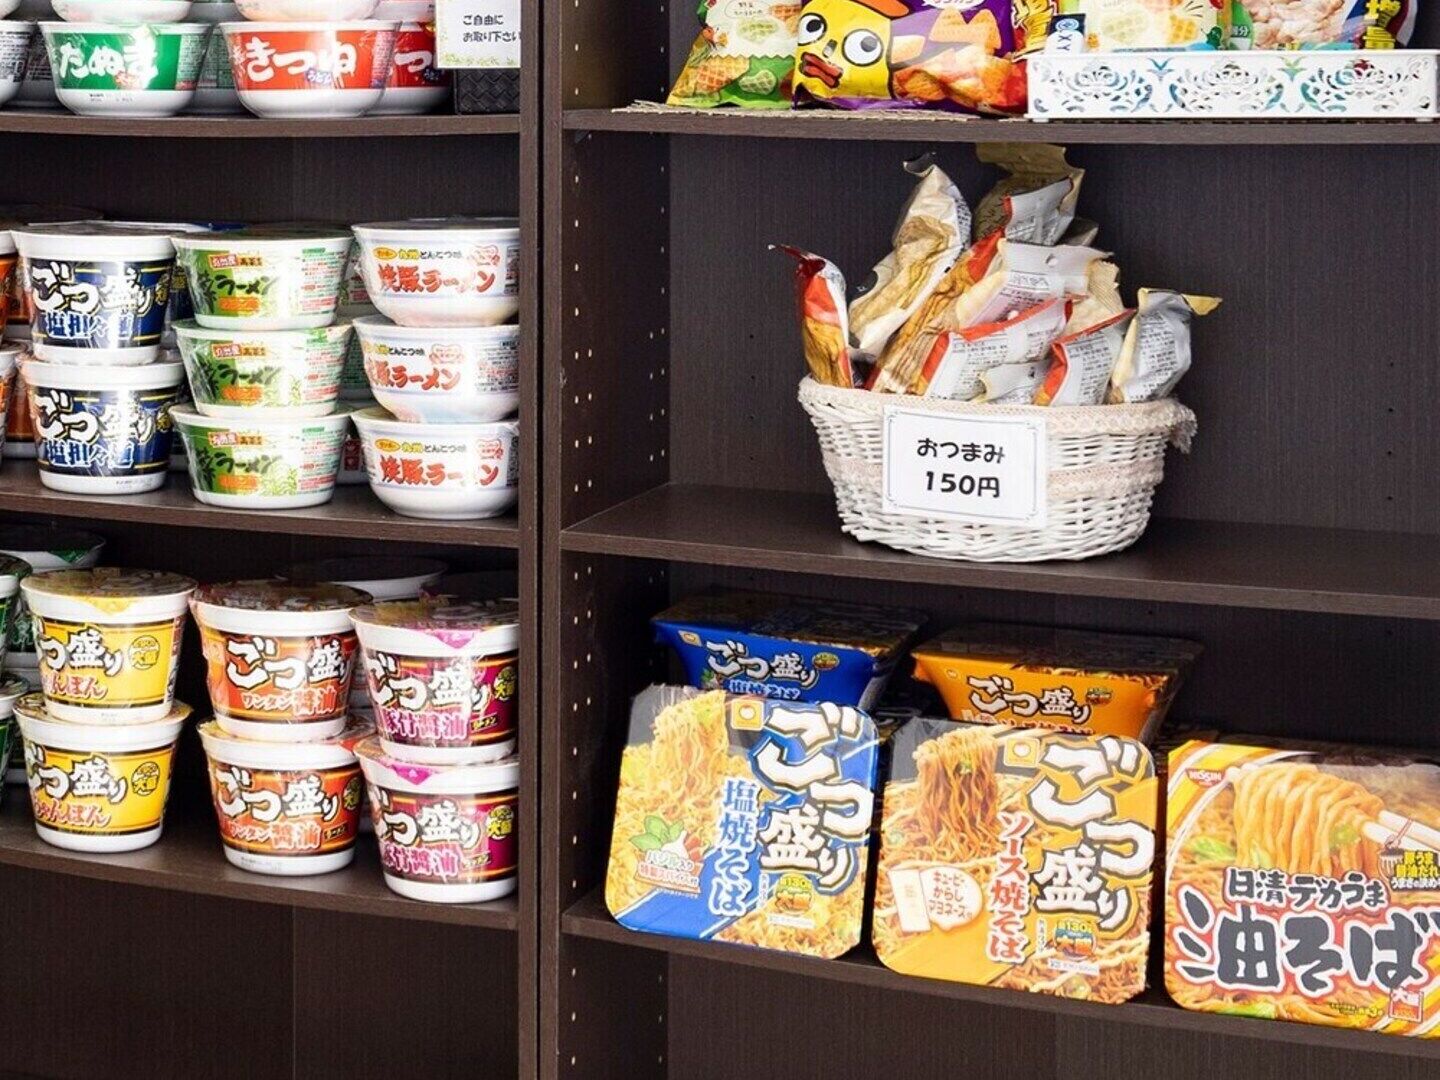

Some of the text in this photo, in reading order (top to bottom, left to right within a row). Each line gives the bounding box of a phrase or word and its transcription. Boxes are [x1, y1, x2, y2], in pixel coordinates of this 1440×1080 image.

[463, 14, 504, 26] ご自由に
[463, 31, 521, 42] お取り下さい
[245, 36, 357, 82] きつね
[378, 263, 496, 293] 焼豚ラーン
[379, 455, 499, 486] 焼豚ラーン
[917, 437, 1006, 465] おつまみ
[925, 470, 1002, 499] 150円
[39, 626, 123, 677] つ盛り
[227, 636, 350, 690] ごつ盛り
[706, 640, 817, 687] ごつ盛り
[967, 675, 1091, 725] ごつ盛り
[216, 767, 339, 822] ごつ盛り
[754, 702, 874, 894] ごつ盛り
[1188, 770, 1222, 782] NISSIN
[709, 779, 759, 917] 塩焼そば
[1028, 736, 1156, 931] ごつ盛り
[933, 886, 964, 902] からし
[991, 812, 1034, 963] ソース焼そば
[1228, 869, 1387, 910] 日清デカうま
[1177, 890, 1440, 992] 油そば
